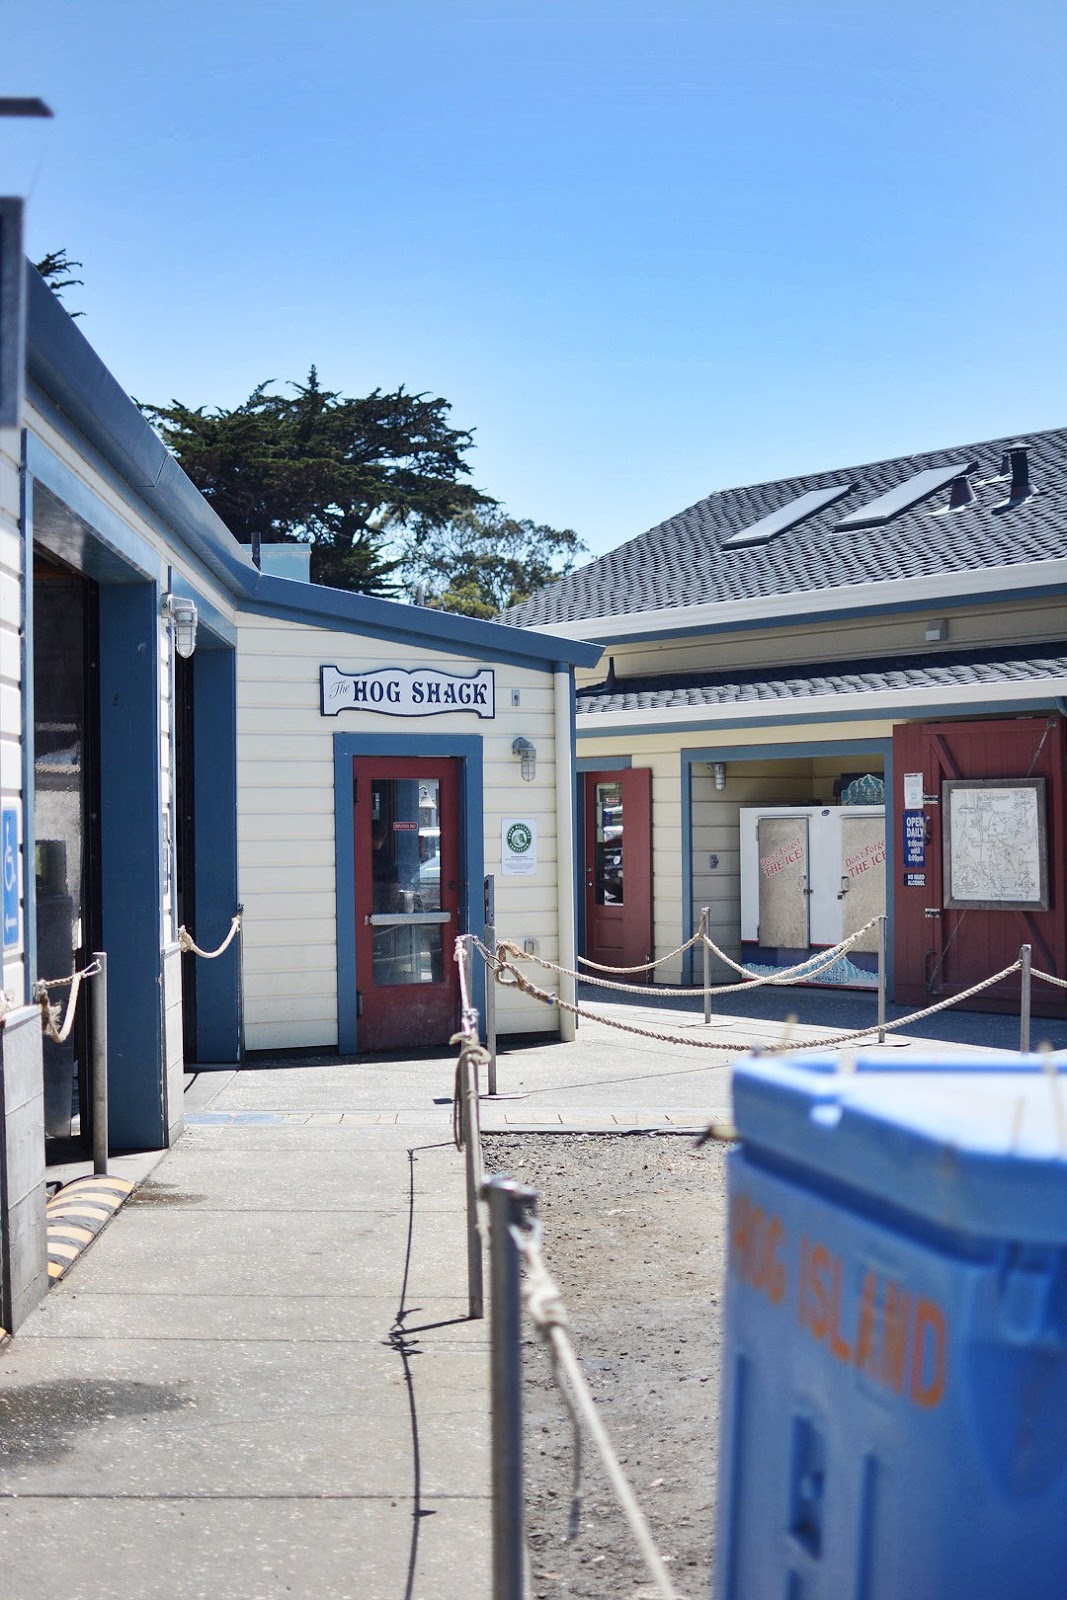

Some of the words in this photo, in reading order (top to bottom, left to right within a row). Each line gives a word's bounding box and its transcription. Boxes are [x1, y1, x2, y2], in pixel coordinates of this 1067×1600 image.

[328, 680, 350, 699] The
[353, 680, 401, 702] HOG
[411, 681, 488, 705] SHACK
[906, 817, 924, 827] OPEN
[906, 827, 924, 838] DAILY
[778, 837, 801, 855] Forget
[846, 851, 865, 868] Don't
[864, 839, 885, 856] Forge
[763, 859, 784, 877] THE
[785, 847, 805, 865] ICE!
[848, 860, 870, 878] THE
[796, 1235, 946, 1411] ISLAND
